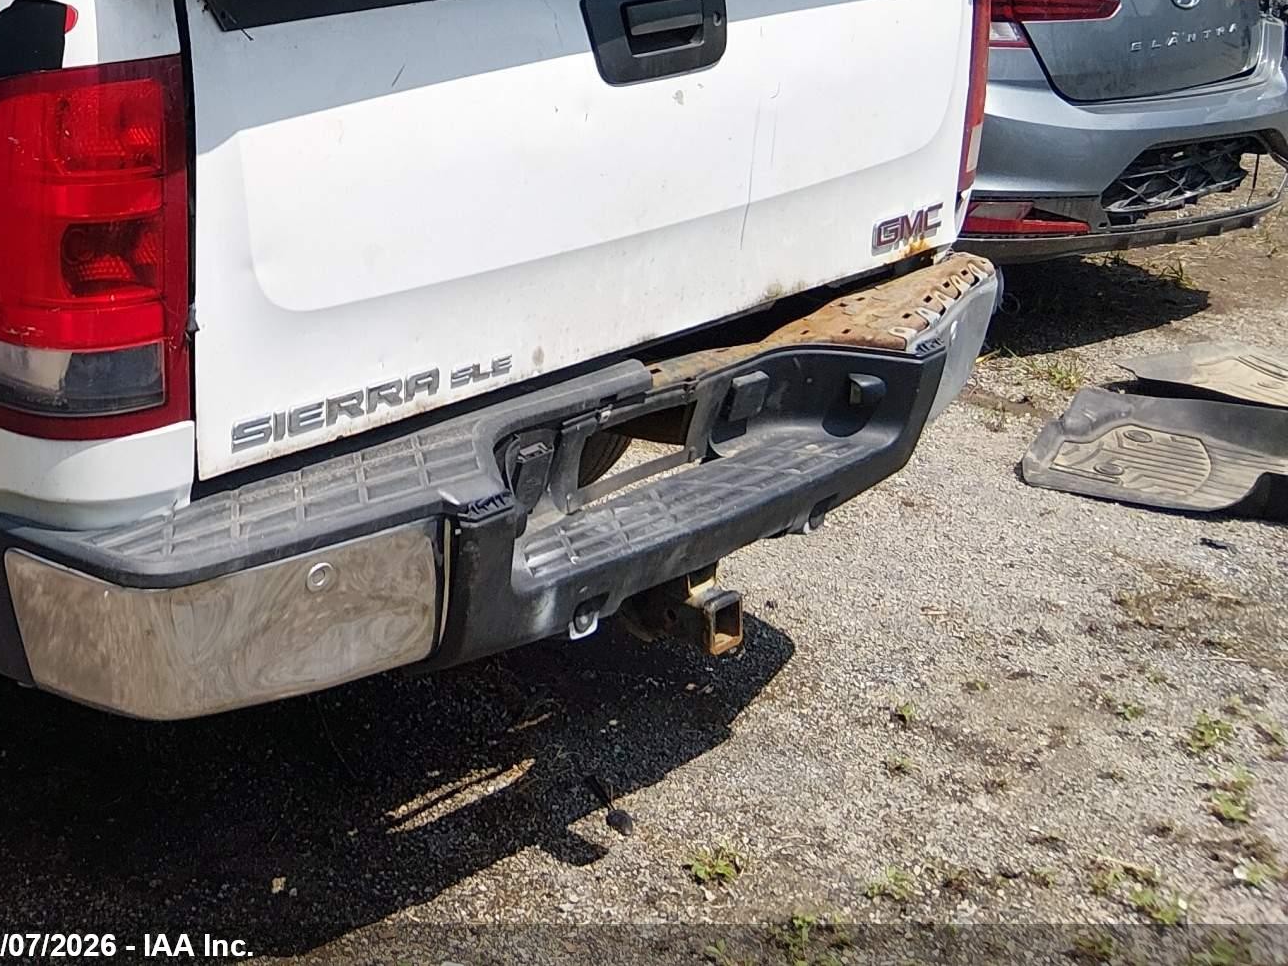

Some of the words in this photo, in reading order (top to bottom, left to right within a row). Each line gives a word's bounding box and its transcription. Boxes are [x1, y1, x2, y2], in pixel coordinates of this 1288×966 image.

[1130, 22, 1238, 52] ELANTRA
[872, 201, 944, 252] GMC
[231, 366, 439, 453] SIERRA
[450, 354, 512, 388] SLE
